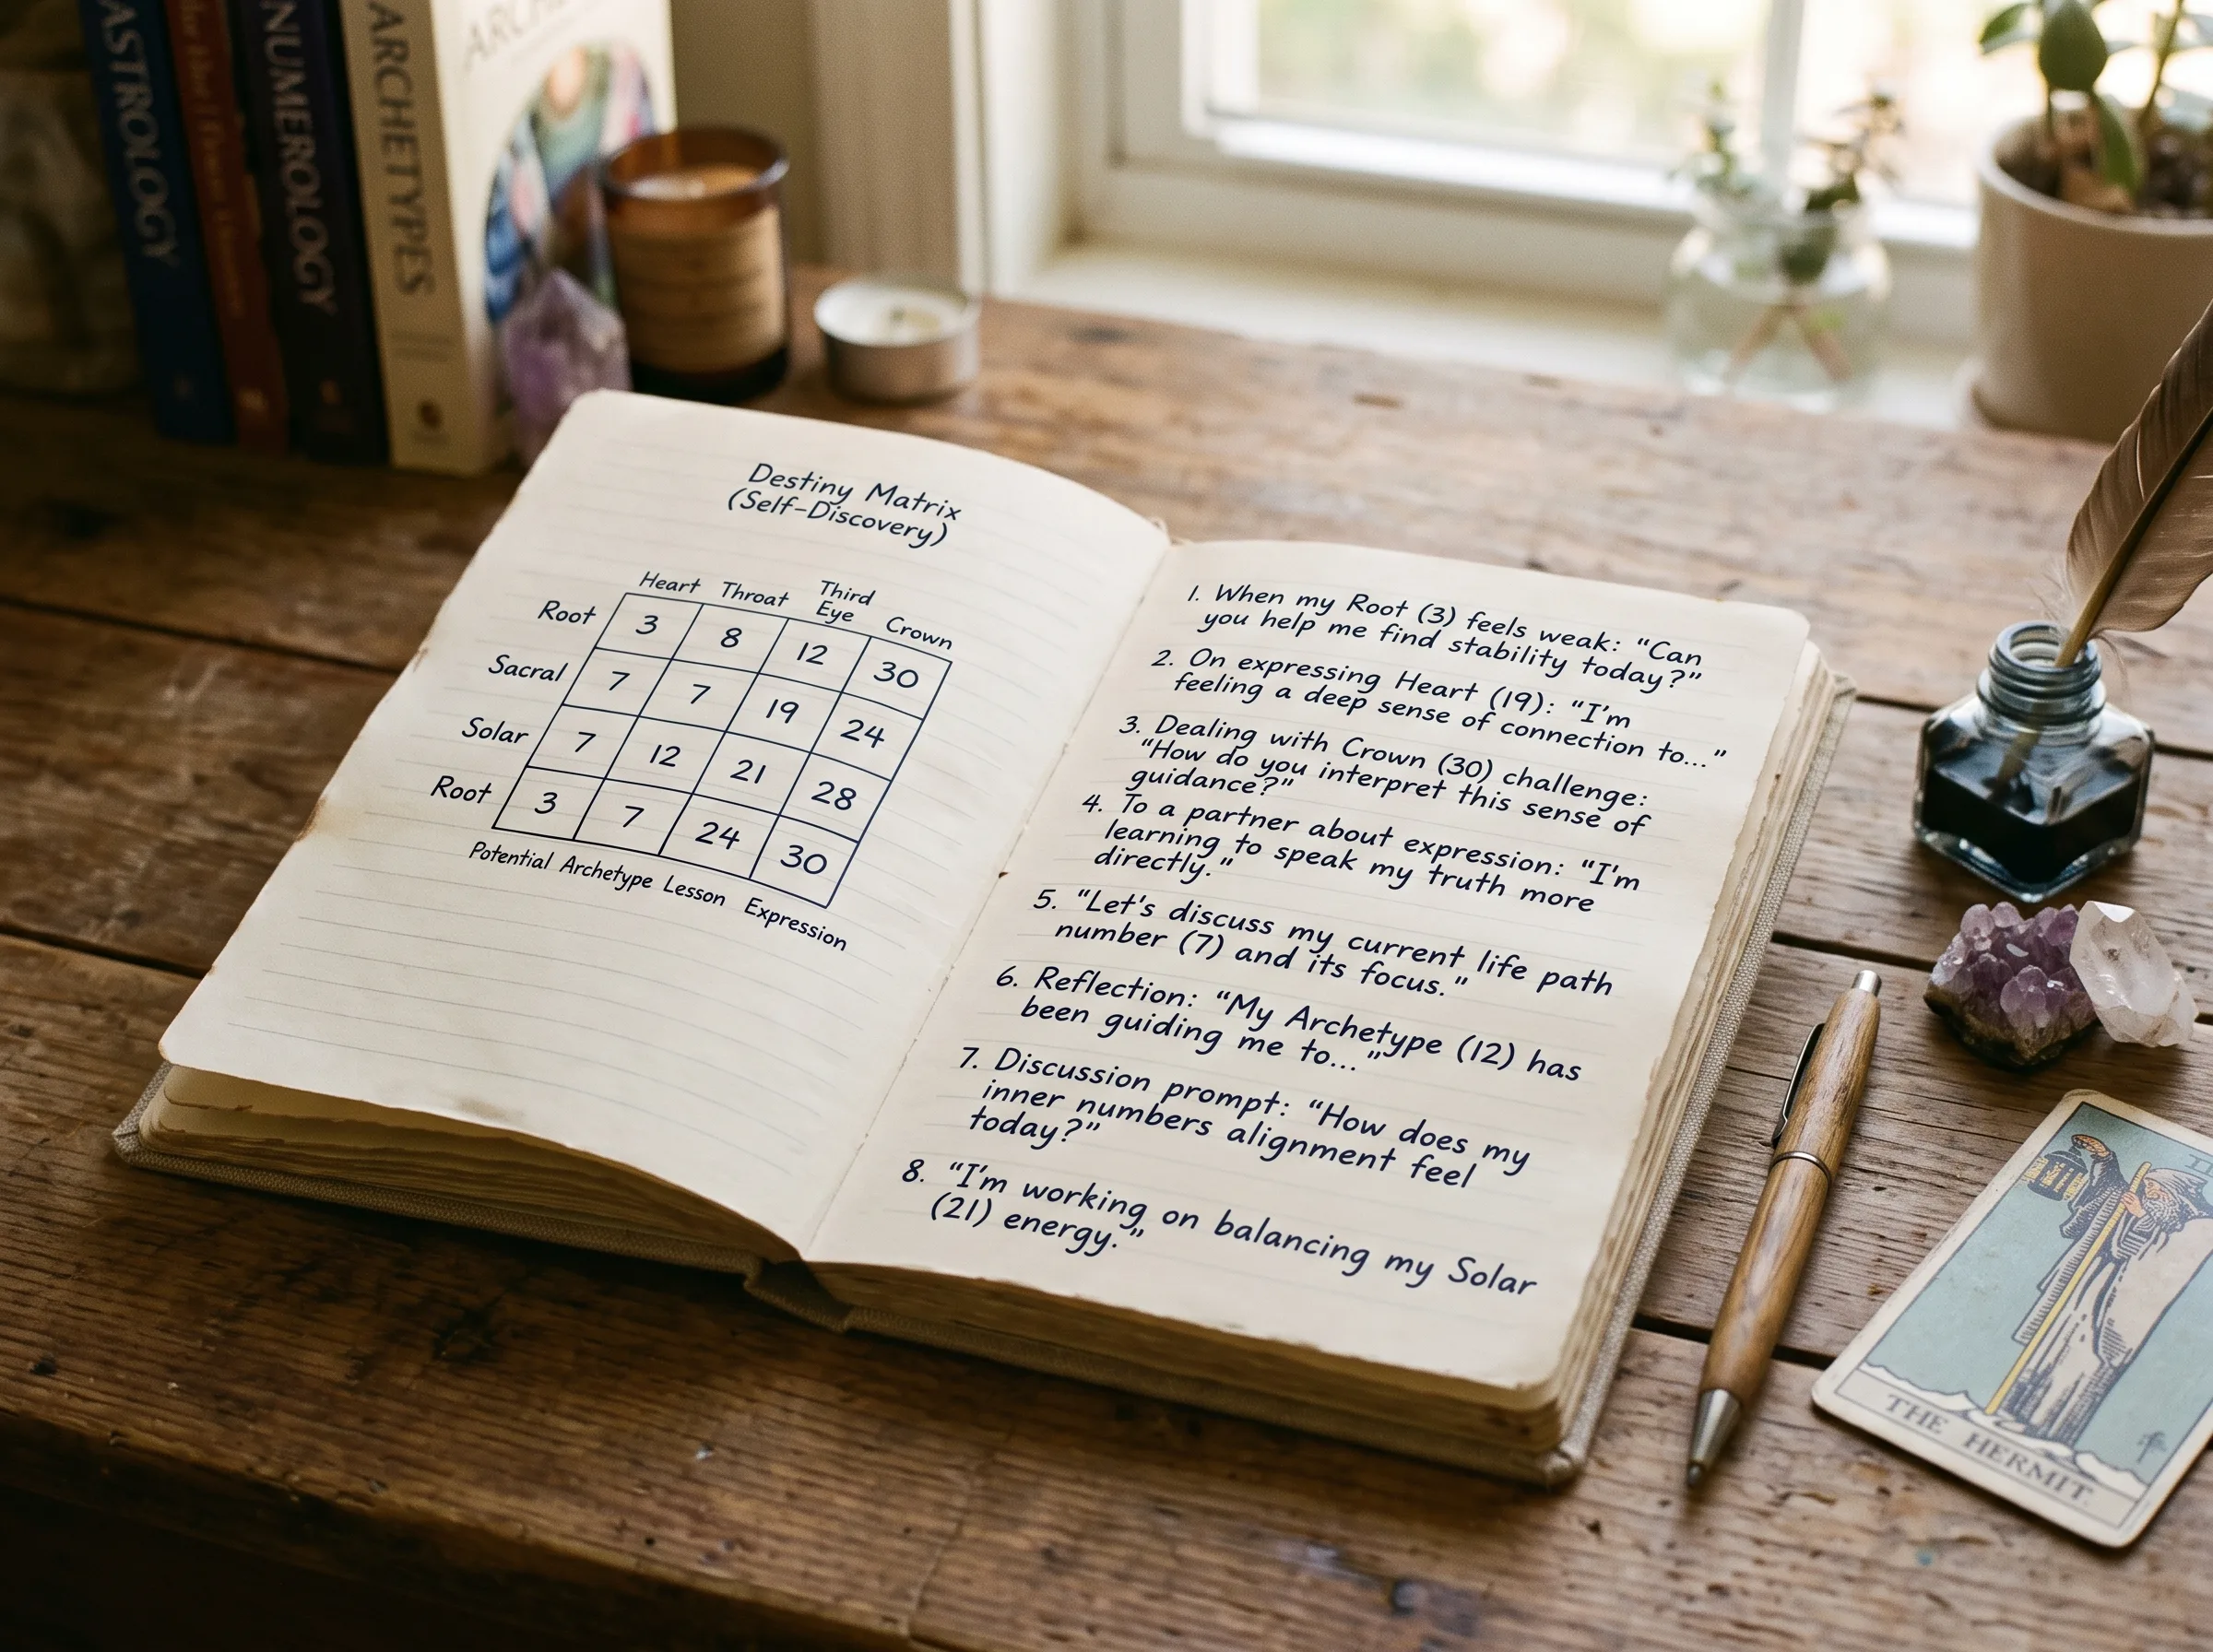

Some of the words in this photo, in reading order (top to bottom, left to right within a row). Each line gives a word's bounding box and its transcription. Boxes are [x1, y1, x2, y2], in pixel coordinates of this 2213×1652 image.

[99, 0, 181, 268] ASTROLOGY
[260, 0, 339, 317] NUMEROLOGY
[368, 2, 433, 297] ARCHETYPES
[728, 487, 949, 550] (Self-Discovery)
[747, 462, 853, 506] Destiny
[864, 482, 963, 521] Matrix
[638, 571, 702, 594] Heart
[721, 581, 790, 608] Throat
[815, 599, 855, 622] Eye
[885, 616, 953, 651] Crown
[820, 579, 877, 607] Third
[1187, 584, 1200, 602] 1.
[1214, 584, 1284, 605] When
[1295, 595, 1336, 617] my
[1345, 593, 1409, 619] Root
[1417, 602, 1457, 628] (3)
[1466, 610, 1528, 639] feels
[1539, 630, 1621, 653] weak:
[537, 599, 597, 625] Root
[634, 614, 659, 635] 3
[719, 627, 743, 649] 8
[796, 642, 828, 666] 12
[872, 661, 919, 689] 30
[1150, 649, 1174, 667] 2.
[1189, 647, 1226, 668] On
[1237, 657, 1381, 695] expressing
[1394, 669, 1479, 702] Heart
[1489, 685, 1555, 716] (19):
[1196, 613, 1250, 633] you
[1260, 608, 1317, 638] help
[1327, 622, 1367, 639] me
[1379, 622, 1442, 649] find
[1447, 636, 1568, 678] stability
[488, 654, 569, 682] Sacral
[609, 670, 631, 691] 7
[690, 683, 712, 705] 7
[765, 698, 799, 725] 19
[839, 718, 885, 749] 24
[1173, 671, 1264, 704] feeling
[1274, 687, 1292, 700] a
[1303, 683, 1367, 716] deep
[1377, 701, 1451, 724] sense
[1461, 711, 1497, 732] of
[1499, 722, 1645, 758] connection
[461, 716, 529, 744] Solar
[574, 731, 598, 753] 7
[649, 744, 681, 768] 12
[729, 759, 767, 785] 21
[811, 780, 858, 811] 28
[1118, 714, 1141, 735] 3.
[1154, 714, 1259, 751] Dealing
[1270, 729, 1329, 753] with
[1342, 737, 1426, 769] Crown
[1438, 752, 1494, 785] (30)
[1502, 766, 1648, 812] challenge:
[1215, 745, 1250, 768] do
[1253, 758, 1308, 778] you
[1318, 761, 1448, 800] interpret
[1458, 783, 1512, 812] this
[1521, 802, 1602, 829] sense
[1613, 813, 1652, 837] of
[430, 774, 492, 805] Root
[533, 791, 558, 815] 3
[621, 805, 645, 829] 7
[694, 820, 740, 851] 24
[779, 844, 828, 875] 30
[1081, 794, 1103, 814] 4.
[1121, 793, 1148, 814] To
[1158, 804, 1176, 818] a
[1181, 805, 1300, 832] partner
[1308, 817, 1394, 848] about
[1403, 838, 1565, 876] expression:
[1104, 818, 1221, 859] learning
[1235, 832, 1262, 856] to
[1273, 846, 1358, 871] speak
[1368, 862, 1414, 891] my
[1427, 863, 1506, 897] truth
[1520, 888, 1595, 913] more
[468, 841, 555, 870] Potential
[558, 855, 654, 892] Archetype
[662, 874, 726, 907] Lesson
[743, 896, 847, 952] Expression
[1032, 889, 1057, 910] 5.
[1168, 899, 1275, 935] discuss
[1286, 926, 1334, 954] my
[1347, 936, 1466, 968] current
[1476, 949, 1528, 981] life
[1535, 969, 1613, 997] path
[1054, 921, 1169, 948] number
[1178, 929, 1225, 961] (7)
[1234, 945, 1300, 970] and
[1307, 952, 1347, 979] its
[996, 964, 1018, 987] 6.
[1033, 965, 1198, 1008] Reflection:
[1284, 1005, 1443, 1059] Archetype
[1456, 1033, 1516, 1071] (12)
[1526, 1048, 1582, 1081] has
[1020, 994, 1090, 1024] been
[1096, 1012, 1224, 1056] guiding
[1237, 1035, 1284, 1056] me
[959, 1046, 980, 1069] 7.
[994, 1046, 1151, 1092] Discussion
[1159, 1081, 1290, 1120] prompt:
[1398, 1118, 1469, 1154] does
[1481, 1144, 1531, 1177] my
[981, 1079, 1066, 1108] inner
[1075, 1098, 1213, 1137] numbers
[1226, 1120, 1397, 1172] alignment
[1410, 1153, 1478, 1188] feel
[901, 1158, 925, 1183] 8.
[1022, 1181, 1148, 1231] working
[1162, 1210, 1200, 1230] on
[1213, 1209, 1370, 1278] balancing
[1383, 1254, 1435, 1289] my
[1447, 1256, 1538, 1295] Solar
[930, 1191, 992, 1229] (21)
[1887, 1393, 1950, 1434] THE
